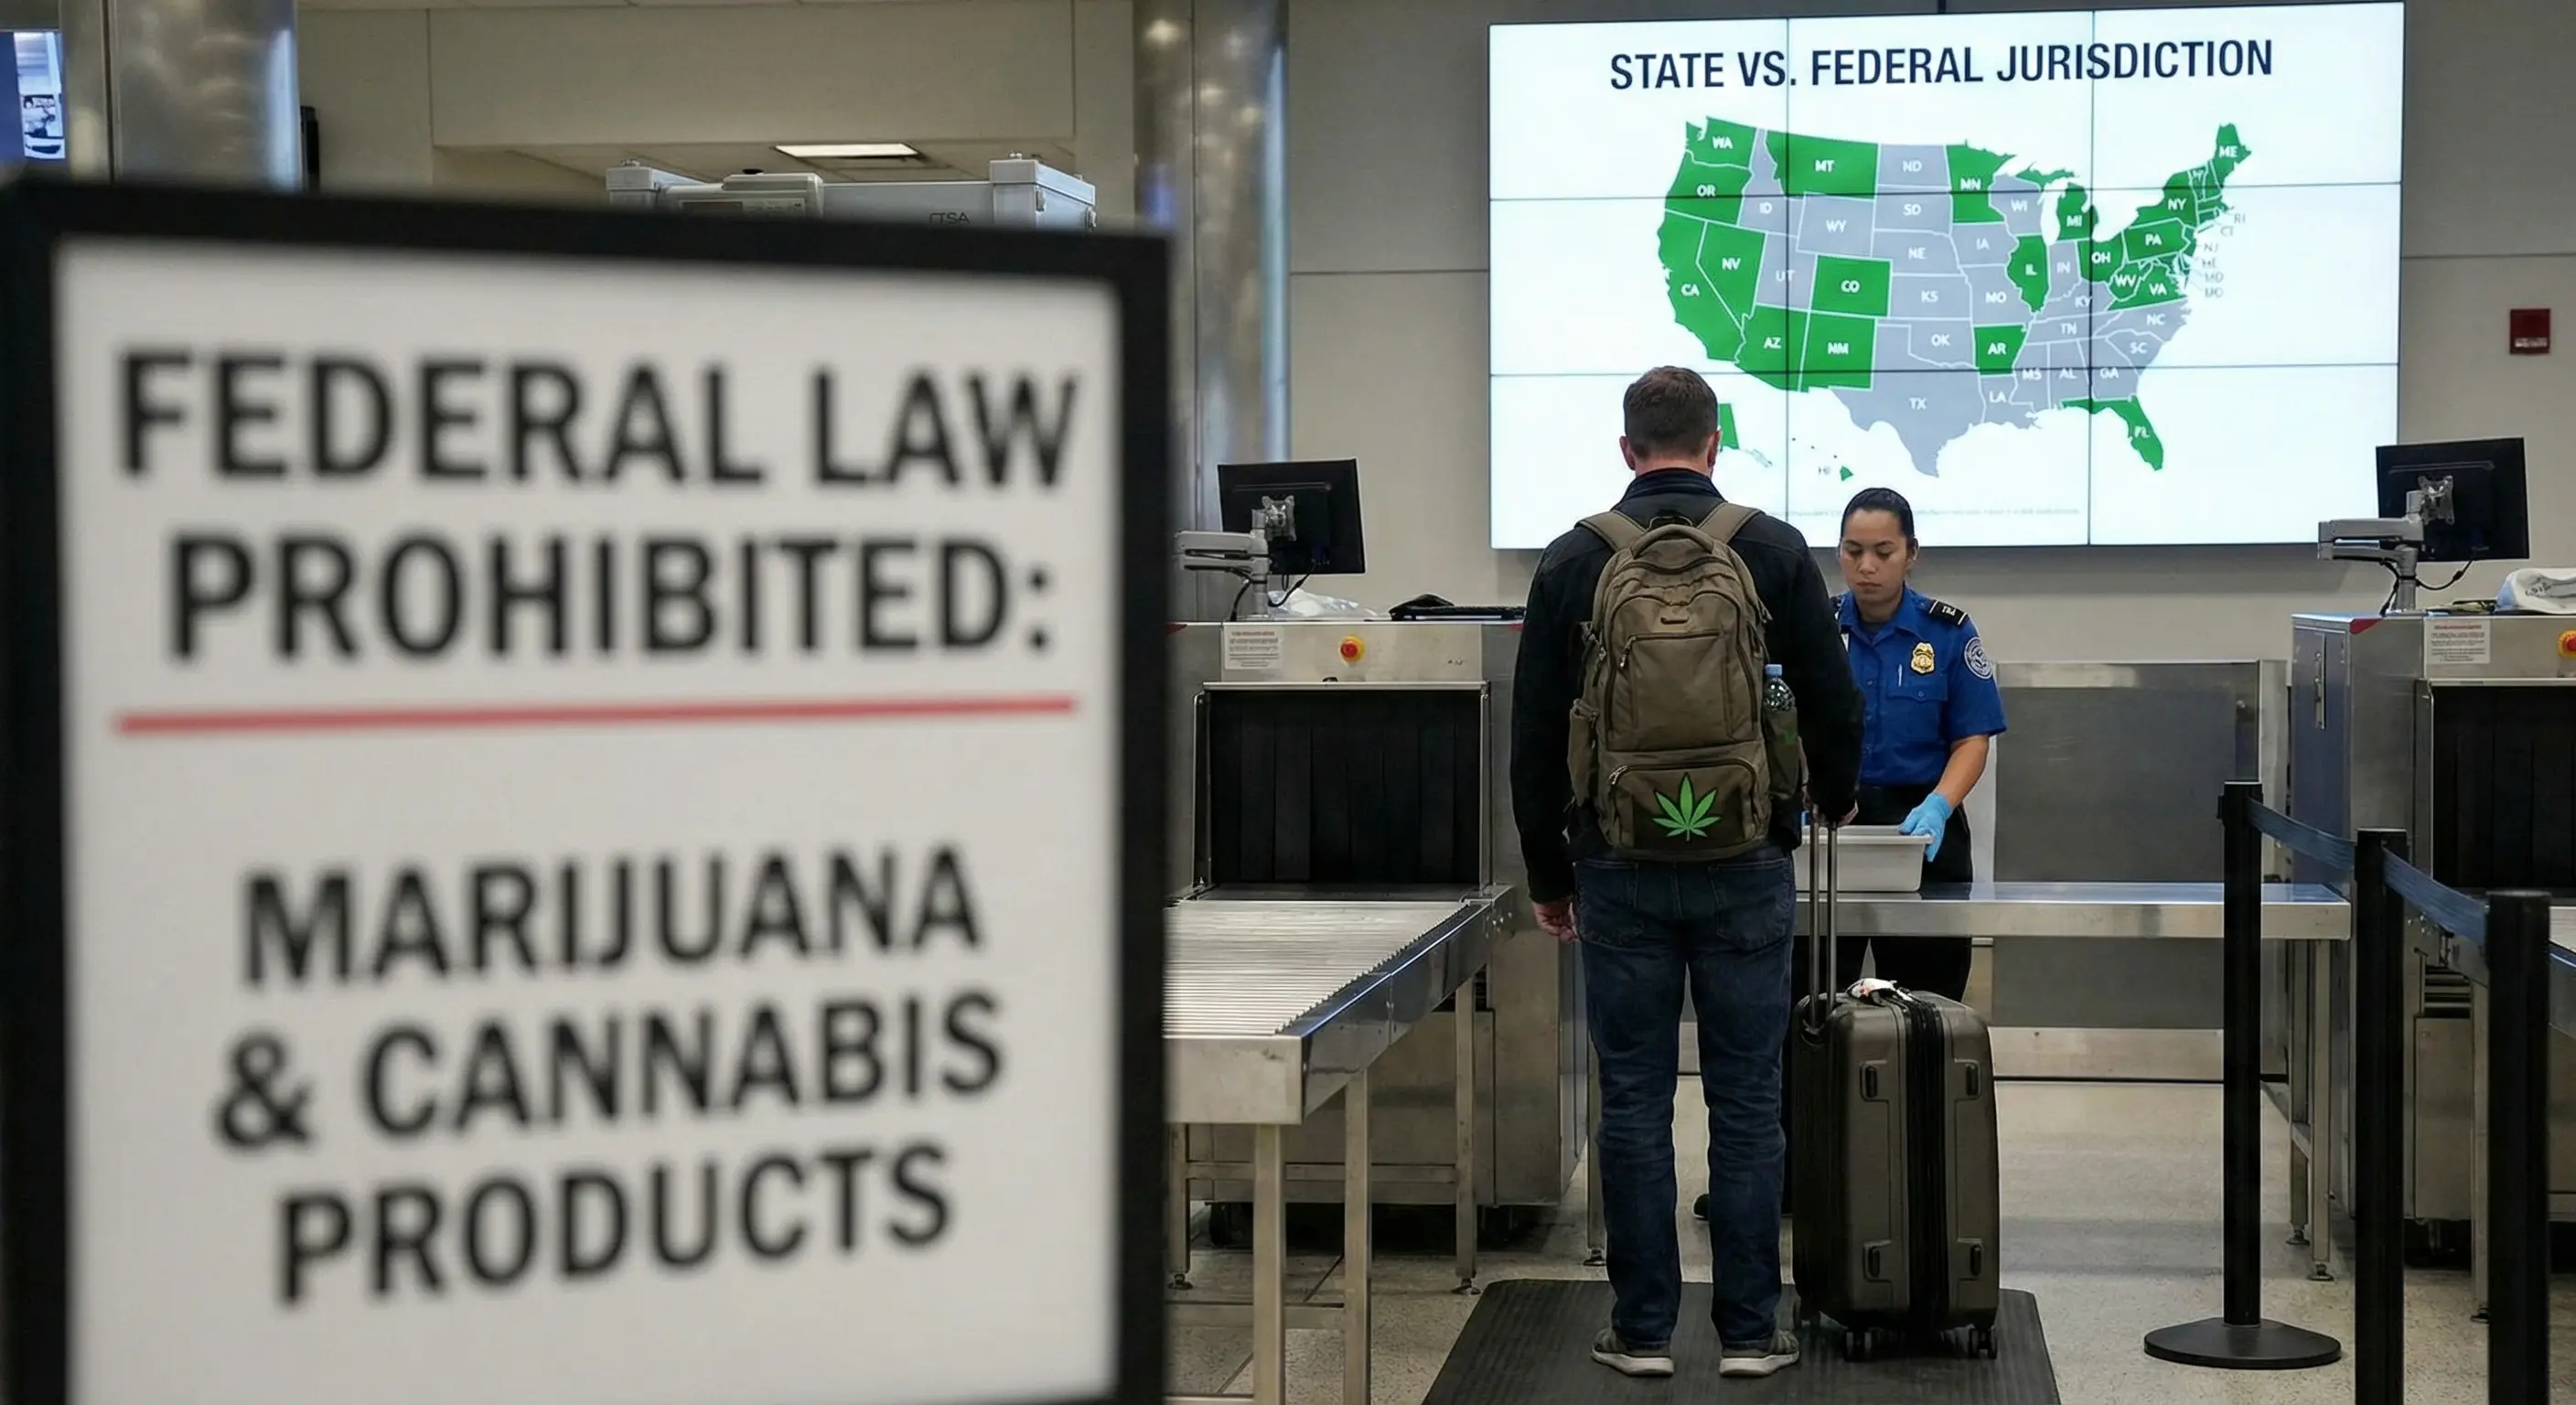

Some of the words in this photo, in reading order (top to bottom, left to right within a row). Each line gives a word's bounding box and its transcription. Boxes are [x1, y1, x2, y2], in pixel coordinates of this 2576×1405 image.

[1610, 52, 1725, 90] STATE
[1737, 49, 1797, 87] VS.
[1811, 47, 1984, 86] FEDERAL
[1996, 38, 2272, 82] JURISDICTION
[1712, 136, 1733, 149] WA
[2219, 145, 2238, 158] ME
[1815, 160, 1835, 172] MT
[1903, 160, 1923, 173] ND
[1960, 178, 1981, 191] MN
[1697, 185, 1716, 197] OR
[1759, 202, 1773, 214] ID
[2011, 199, 2028, 212] WI
[2167, 198, 2187, 210] NY
[1826, 220, 1847, 232] WY
[2066, 215, 2083, 228] MI
[1977, 239, 1990, 251] IA
[2145, 233, 2163, 246] PA
[1908, 247, 1927, 259] NE
[2091, 252, 2111, 263] OH
[1722, 258, 1741, 270] NV
[2025, 264, 2037, 276] IL
[2057, 262, 2071, 273] IN
[1776, 270, 1797, 282] UT
[2115, 275, 2138, 287] WV
[1680, 284, 1700, 296] CA
[1841, 280, 1861, 293] CO
[2148, 284, 2168, 295] VA
[1921, 291, 1939, 303] KS
[1985, 291, 2007, 304] MO
[2075, 295, 2093, 307] KY
[2146, 314, 2166, 327] NC
[2060, 322, 2077, 335] TN
[1763, 337, 1782, 349] AZ
[1931, 334, 1950, 346] OK
[1827, 342, 1849, 354] NM
[1987, 342, 2006, 355] AR
[2130, 342, 2148, 354] SC
[2022, 369, 2042, 381] MS
[2059, 368, 2077, 380] AL
[1989, 391, 2006, 403] LA
[1908, 397, 1927, 410] TX
[118, 349, 767, 485] FEDERAL
[810, 368, 1081, 489] LAW
[168, 529, 1052, 662] PROHIBITED:
[240, 841, 983, 990] MARIJUANA
[212, 1031, 317, 1153] &
[362, 987, 1004, 1141] CANNABIS
[276, 1138, 954, 1308] PRODUCTS
